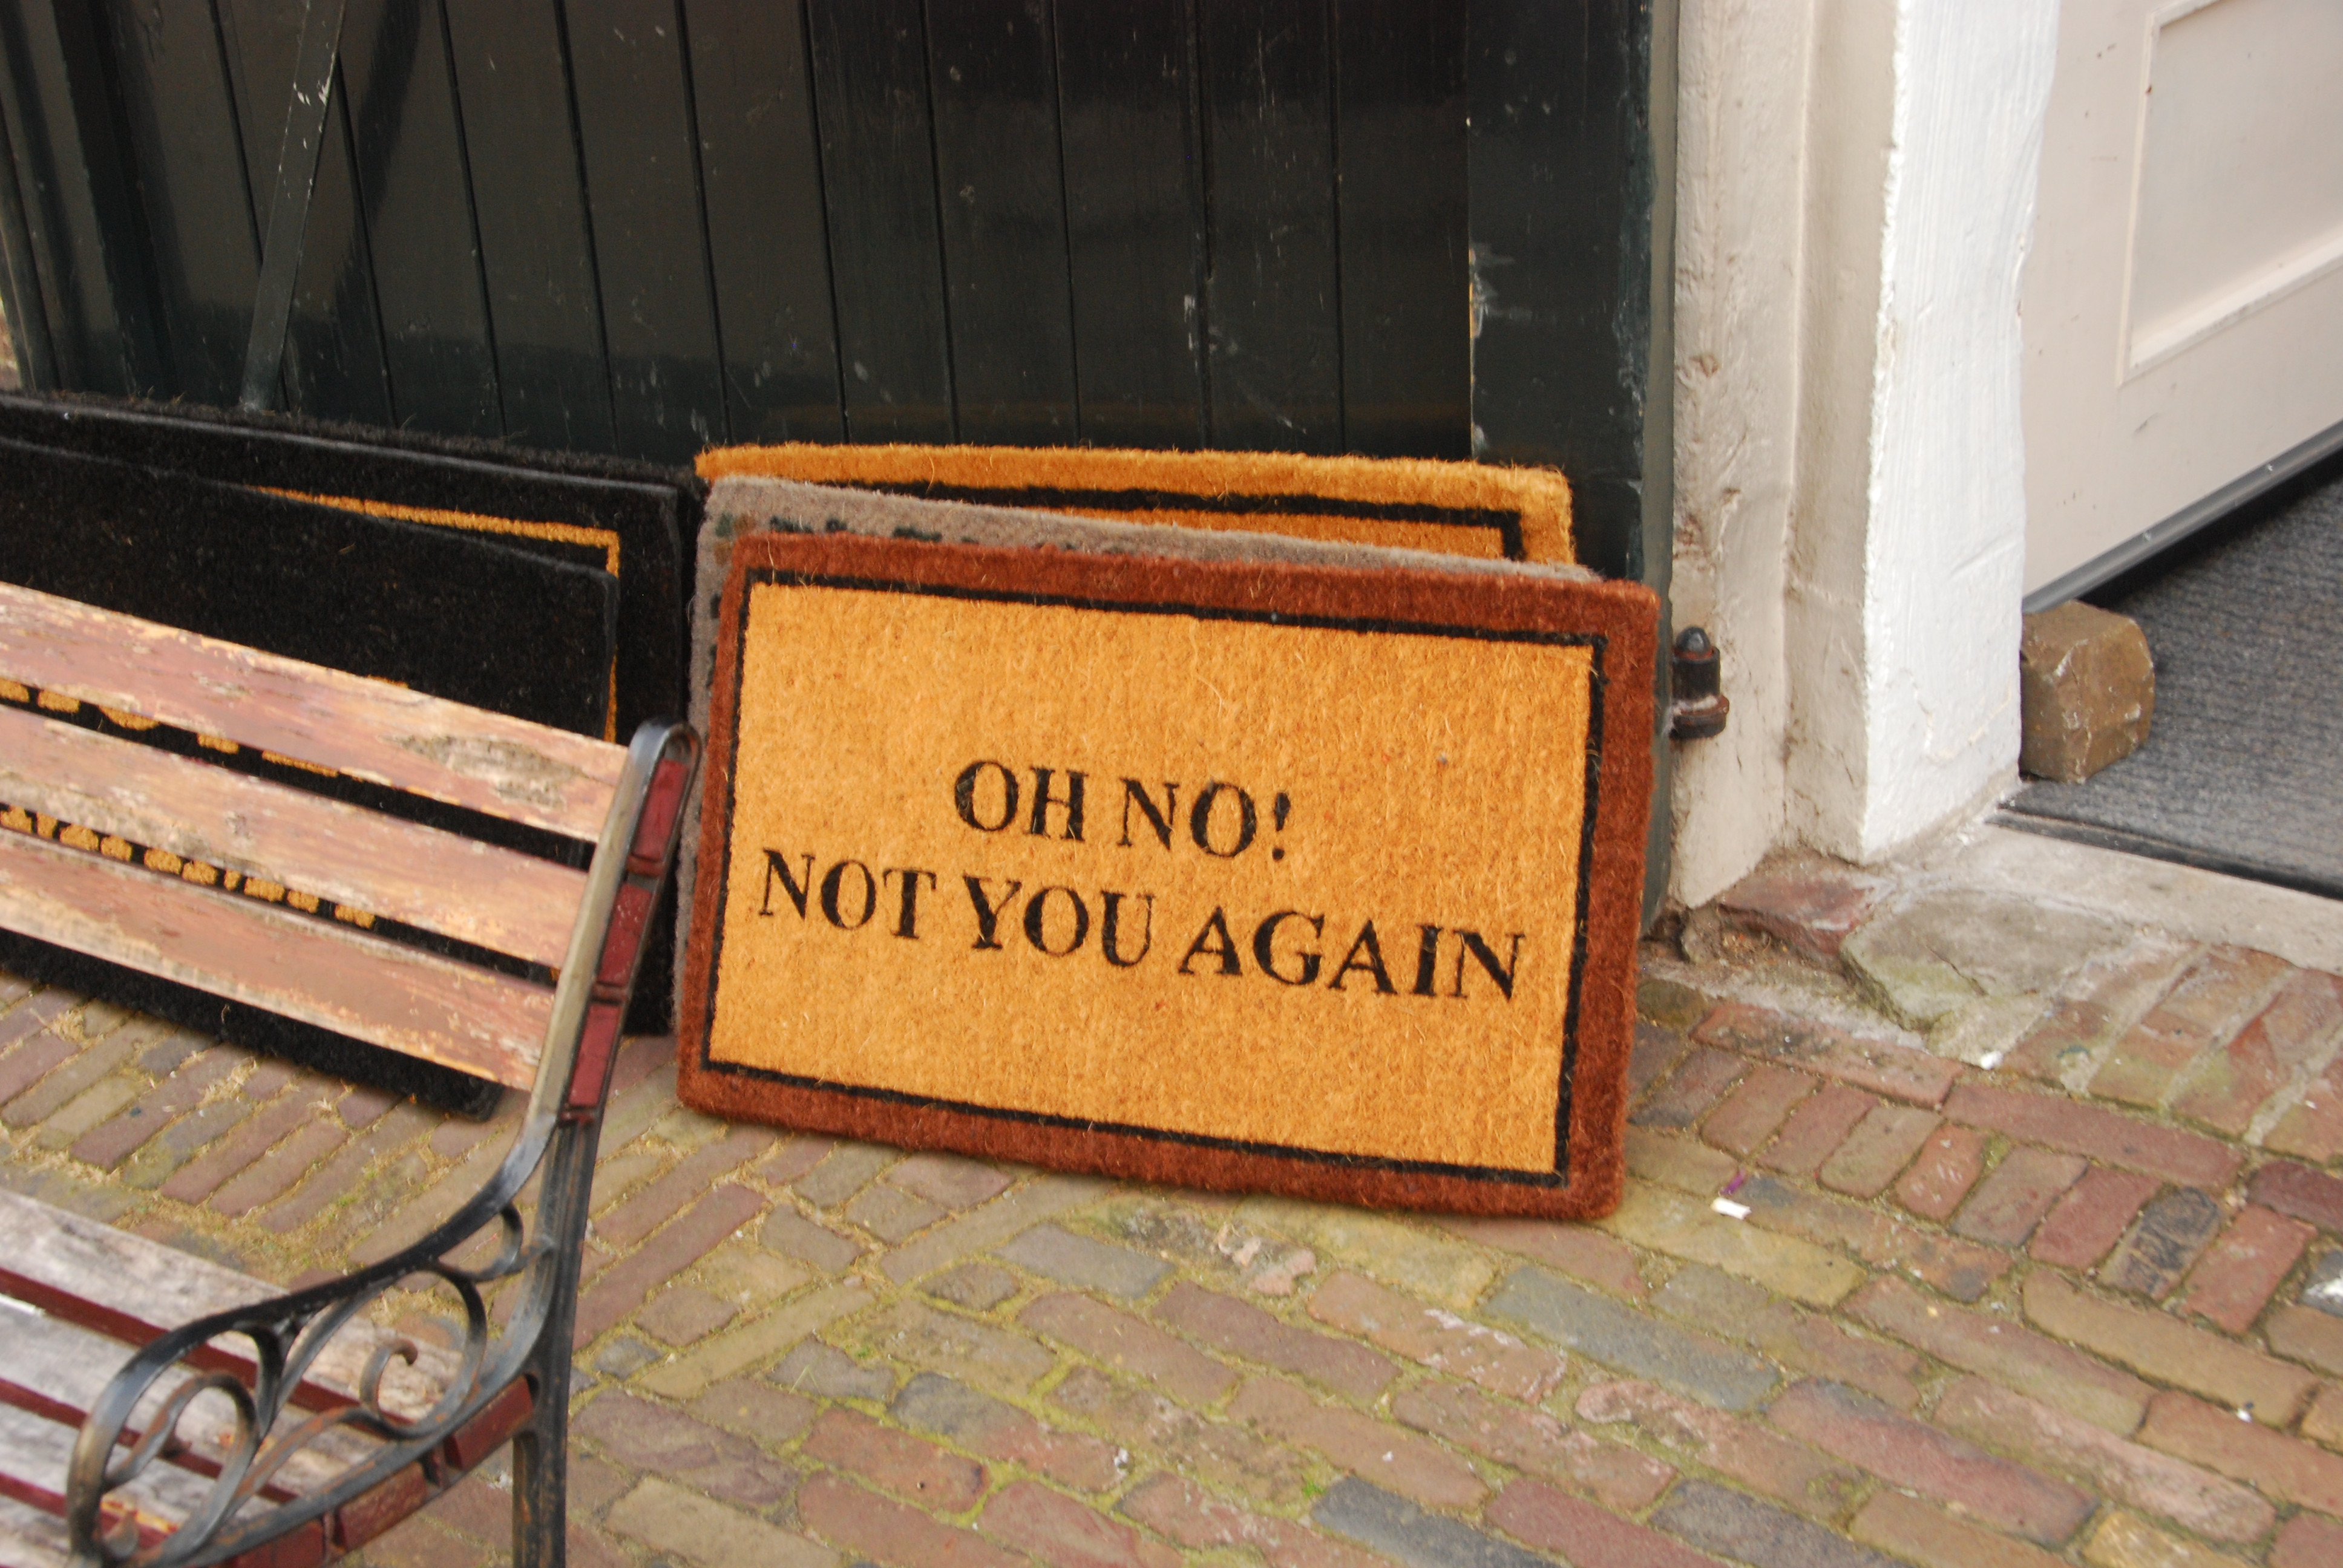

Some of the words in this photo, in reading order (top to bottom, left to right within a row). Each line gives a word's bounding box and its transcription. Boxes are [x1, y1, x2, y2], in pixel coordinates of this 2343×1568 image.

[954, 761, 1087, 842] OH
[1118, 778, 1291, 860] NO!
[758, 849, 936, 939] NOT
[962, 874, 1155, 967] YOU
[1179, 906, 1525, 1001] AGAIN
